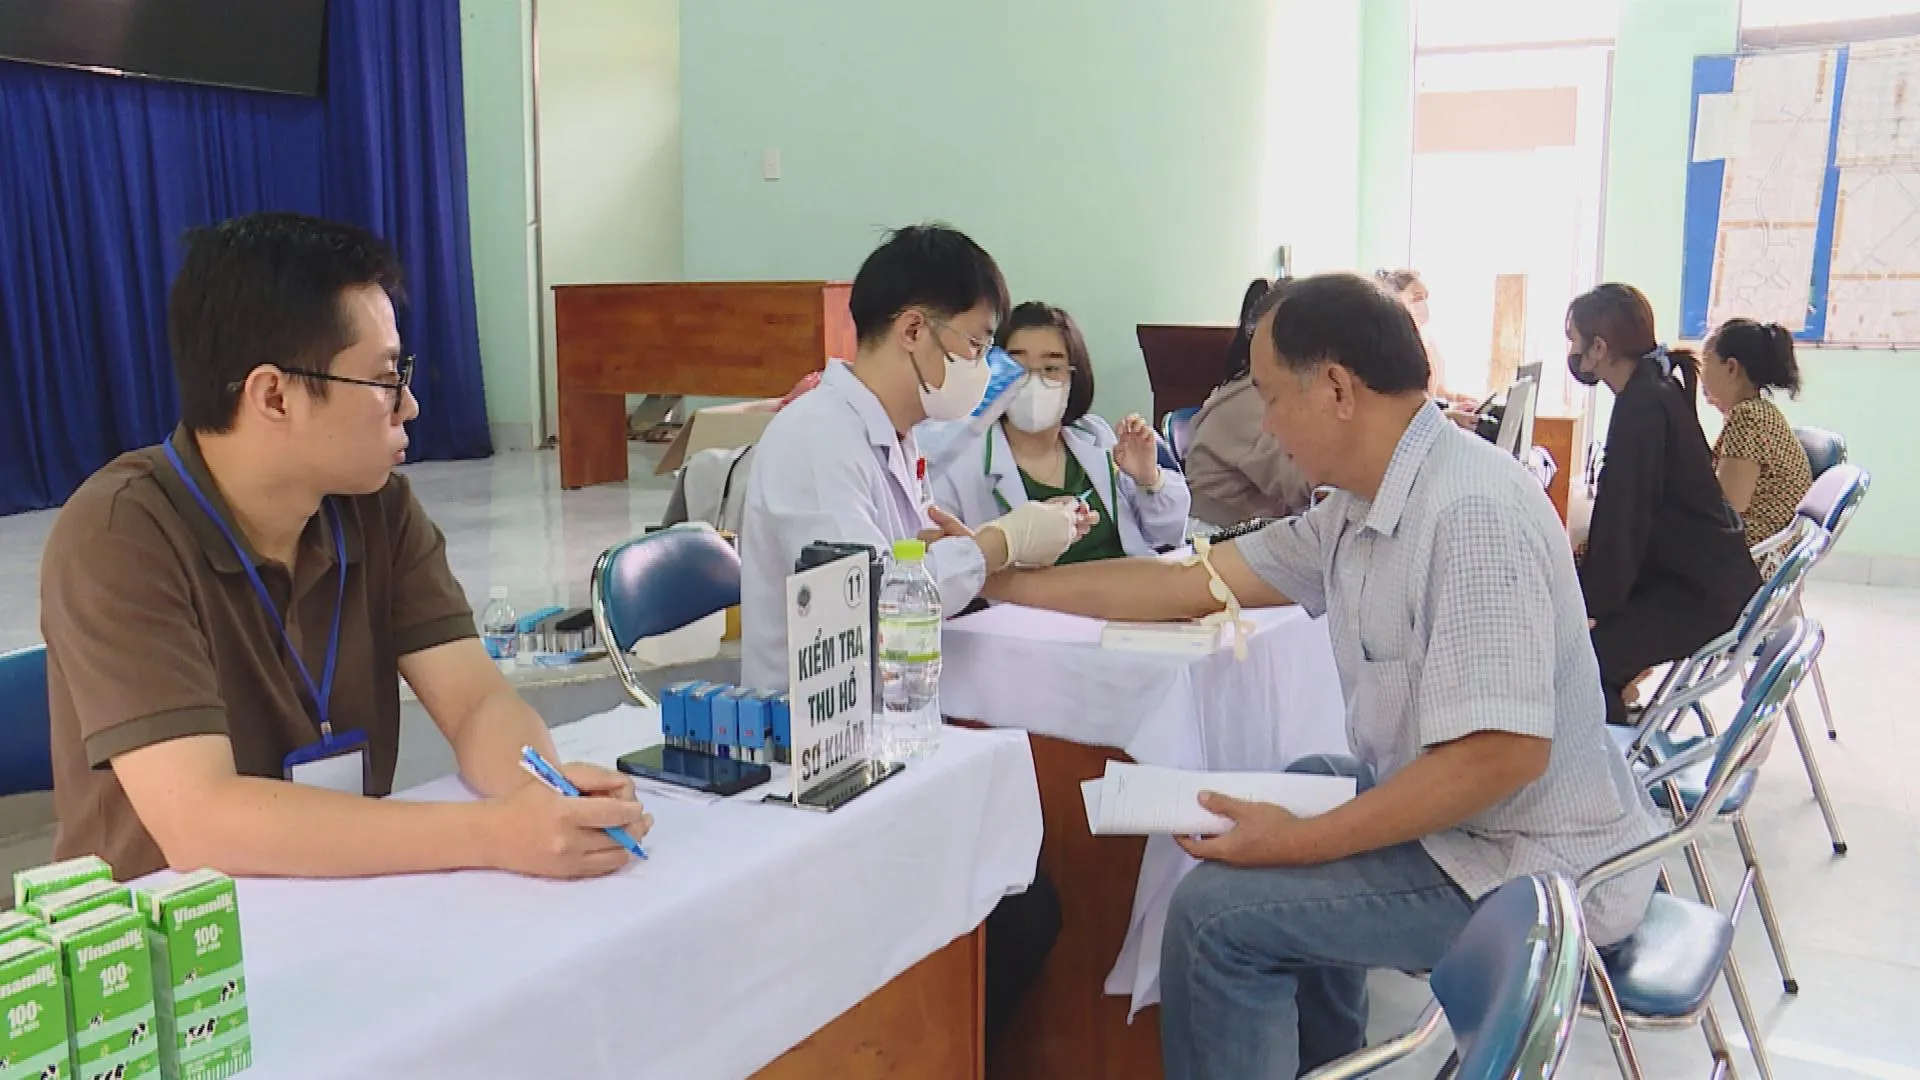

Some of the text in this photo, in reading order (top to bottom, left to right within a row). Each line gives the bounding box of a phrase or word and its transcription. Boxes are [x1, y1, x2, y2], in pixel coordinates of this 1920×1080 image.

[848, 573, 861, 601] 11
[798, 625, 864, 681] KIỂM TRA
[808, 686, 834, 727] THU
[802, 720, 864, 781] SƠ KHÁM
